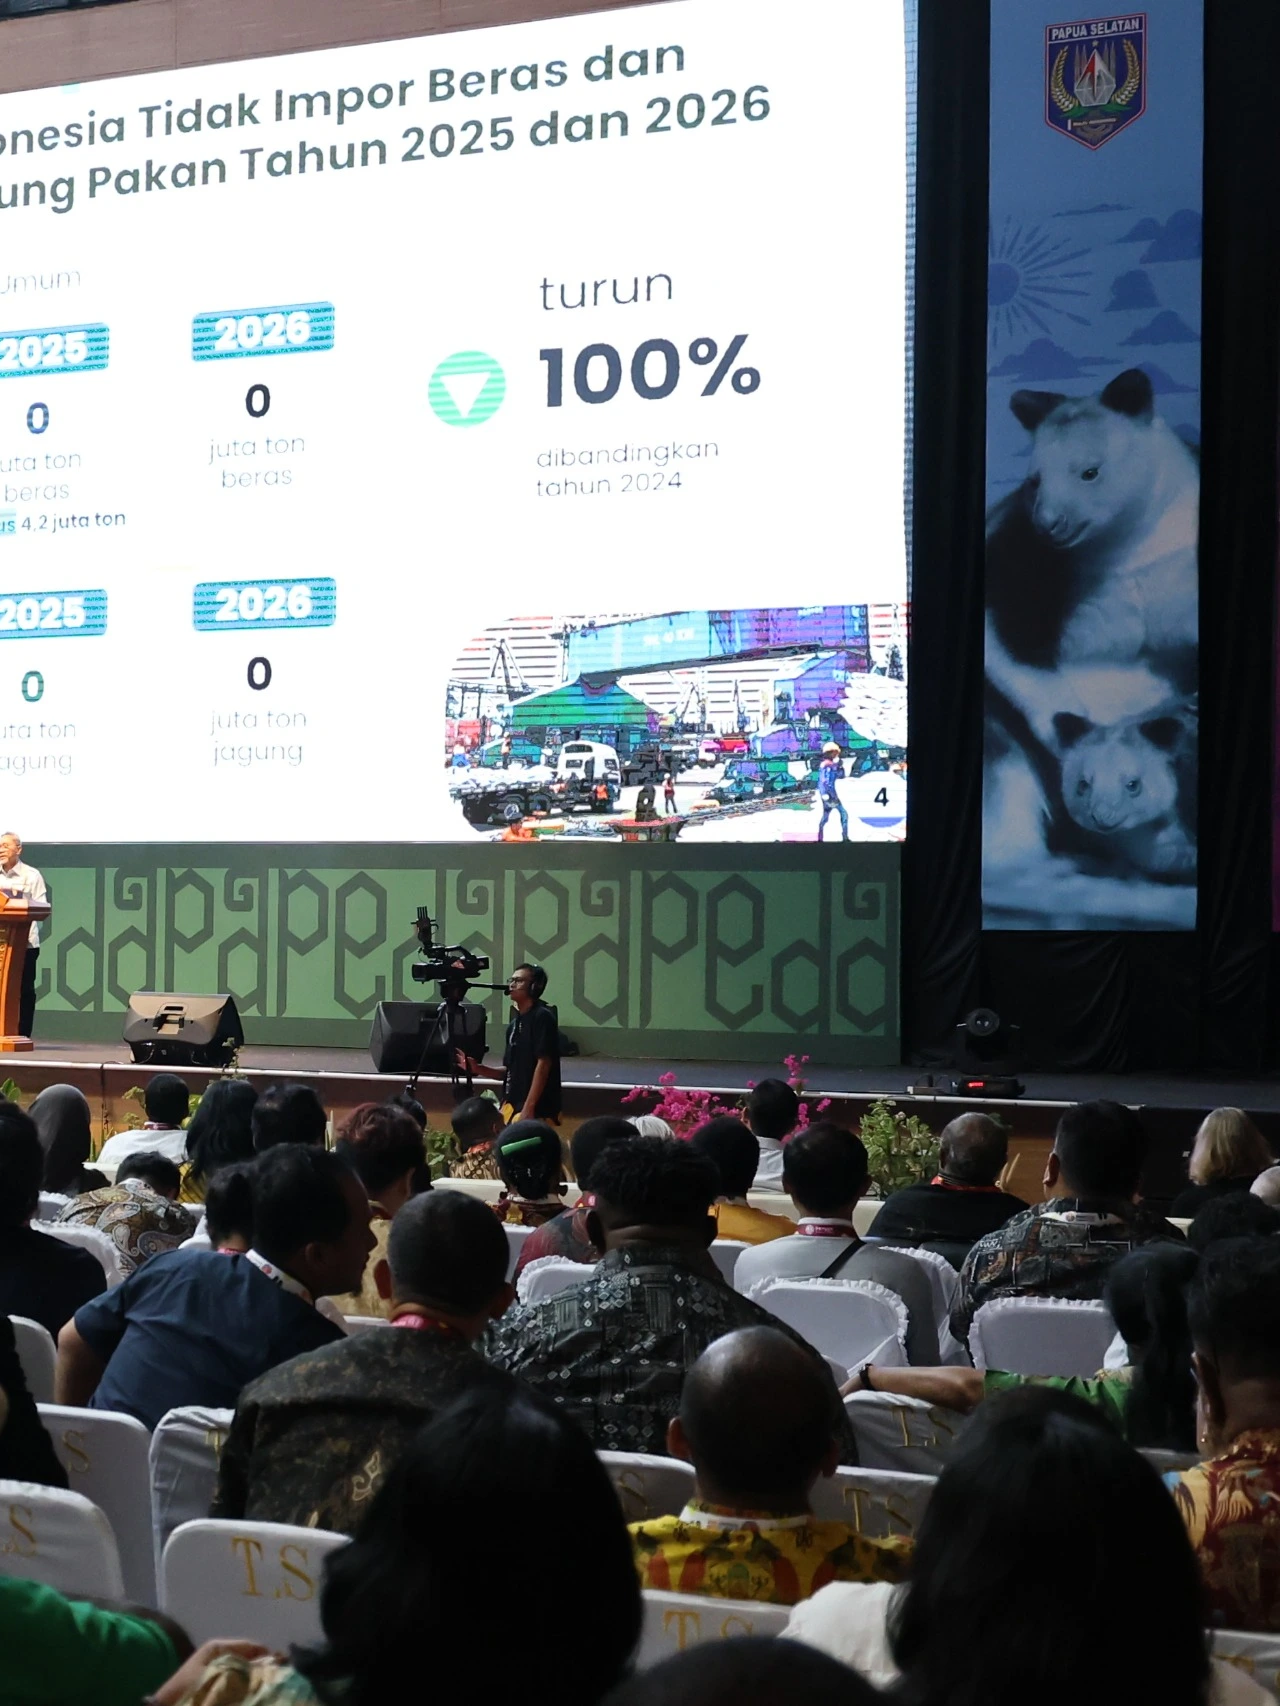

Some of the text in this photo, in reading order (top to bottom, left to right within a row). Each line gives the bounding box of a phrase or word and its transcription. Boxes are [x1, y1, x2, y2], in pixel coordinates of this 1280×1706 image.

[1051, 18, 1140, 41] PAPUA SELATAN
[139, 93, 261, 138] Tidak
[275, 80, 415, 122] Impor
[429, 60, 568, 103] Beras
[583, 45, 685, 83] dan
[88, 159, 227, 199] Pakan
[240, 139, 387, 180] Tahun
[401, 116, 515, 163] 2025
[529, 111, 629, 147] dan
[645, 85, 771, 134] 2026
[539, 272, 673, 311] turun
[214, 310, 312, 352] 2026
[539, 333, 762, 408] 100%
[244, 383, 271, 419] 0
[26, 402, 50, 435] 0
[44, 452, 81, 472] ton
[208, 435, 305, 466] juta ton
[537, 440, 719, 469] dibandingkan
[4, 481, 70, 503] beras
[221, 466, 293, 489] beras
[537, 471, 683, 497] tahun 2024
[51, 513, 90, 533] juta
[94, 511, 126, 527] ton
[214, 584, 312, 623] 2026
[21, 670, 45, 703] 0
[246, 656, 273, 691] 0
[40, 720, 77, 740] ton
[210, 708, 307, 734] juta ton
[213, 740, 303, 767] jagung
[873, 787, 890, 808] 4
[841, 1487, 917, 1537] TS
[231, 1535, 316, 1601] T.S
